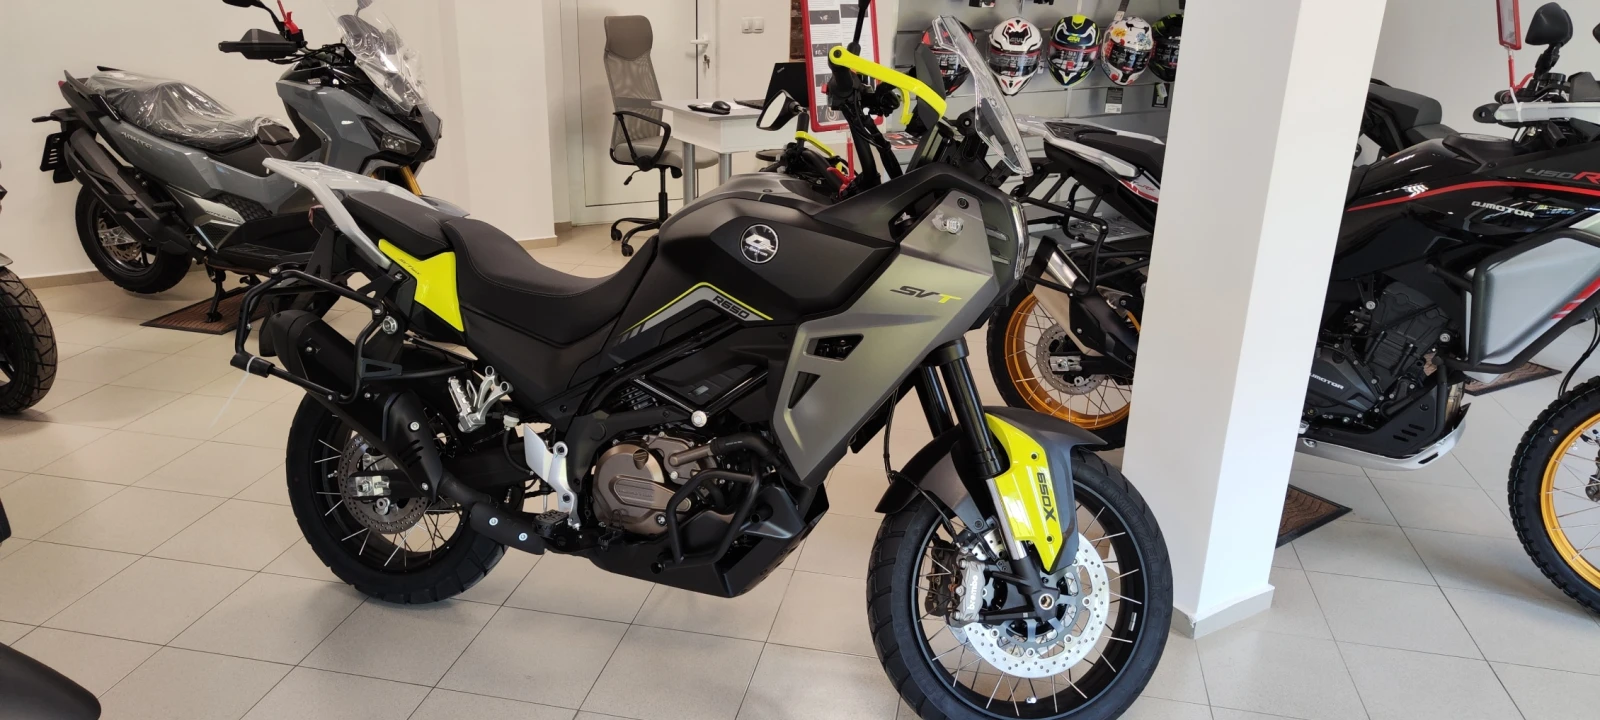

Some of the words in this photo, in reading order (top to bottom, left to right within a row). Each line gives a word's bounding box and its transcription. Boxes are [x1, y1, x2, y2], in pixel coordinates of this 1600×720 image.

[1471, 200, 1535, 219] QJMOTOR
[889, 285, 962, 304] SVT
[712, 295, 750, 319] R650
[1309, 372, 1344, 389] JMOTOR
[1036, 472, 1057, 522] 650X
[967, 575, 979, 610] brembo
